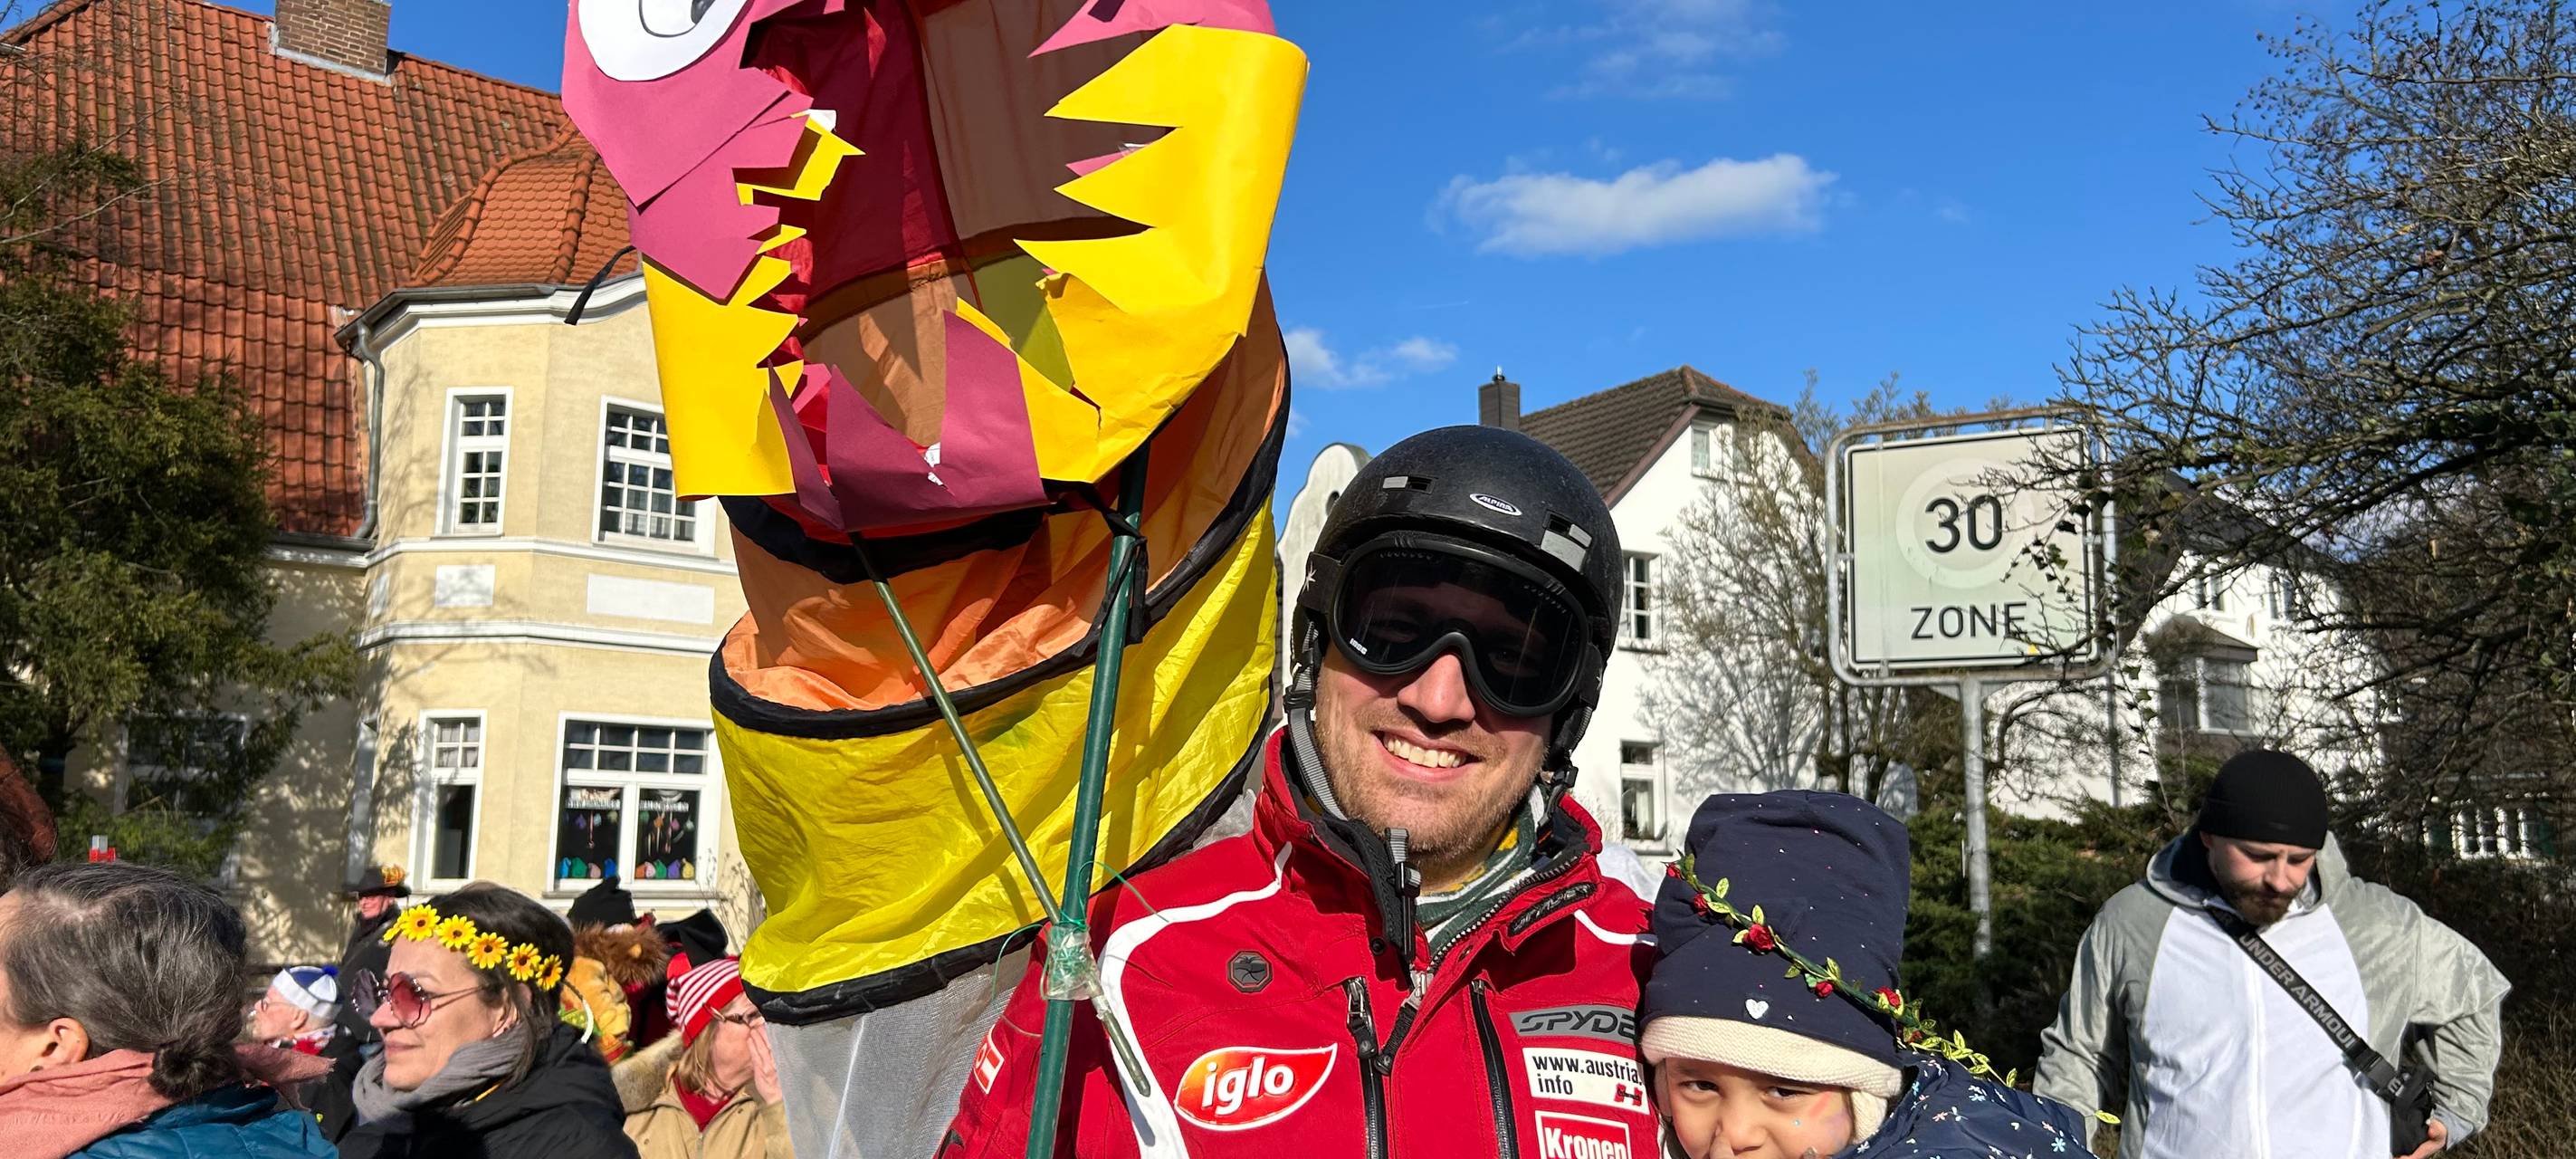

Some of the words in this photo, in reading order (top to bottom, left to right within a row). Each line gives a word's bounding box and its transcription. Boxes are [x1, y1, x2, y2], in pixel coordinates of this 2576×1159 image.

[1924, 494, 2003, 553] 30
[1910, 601, 2027, 641] ZONE
[2238, 933, 2296, 987] UNDER
[1201, 1057, 1294, 1116] iglo
[1537, 1073, 1574, 1096] info
[1544, 1126, 1627, 1159] Kronen
